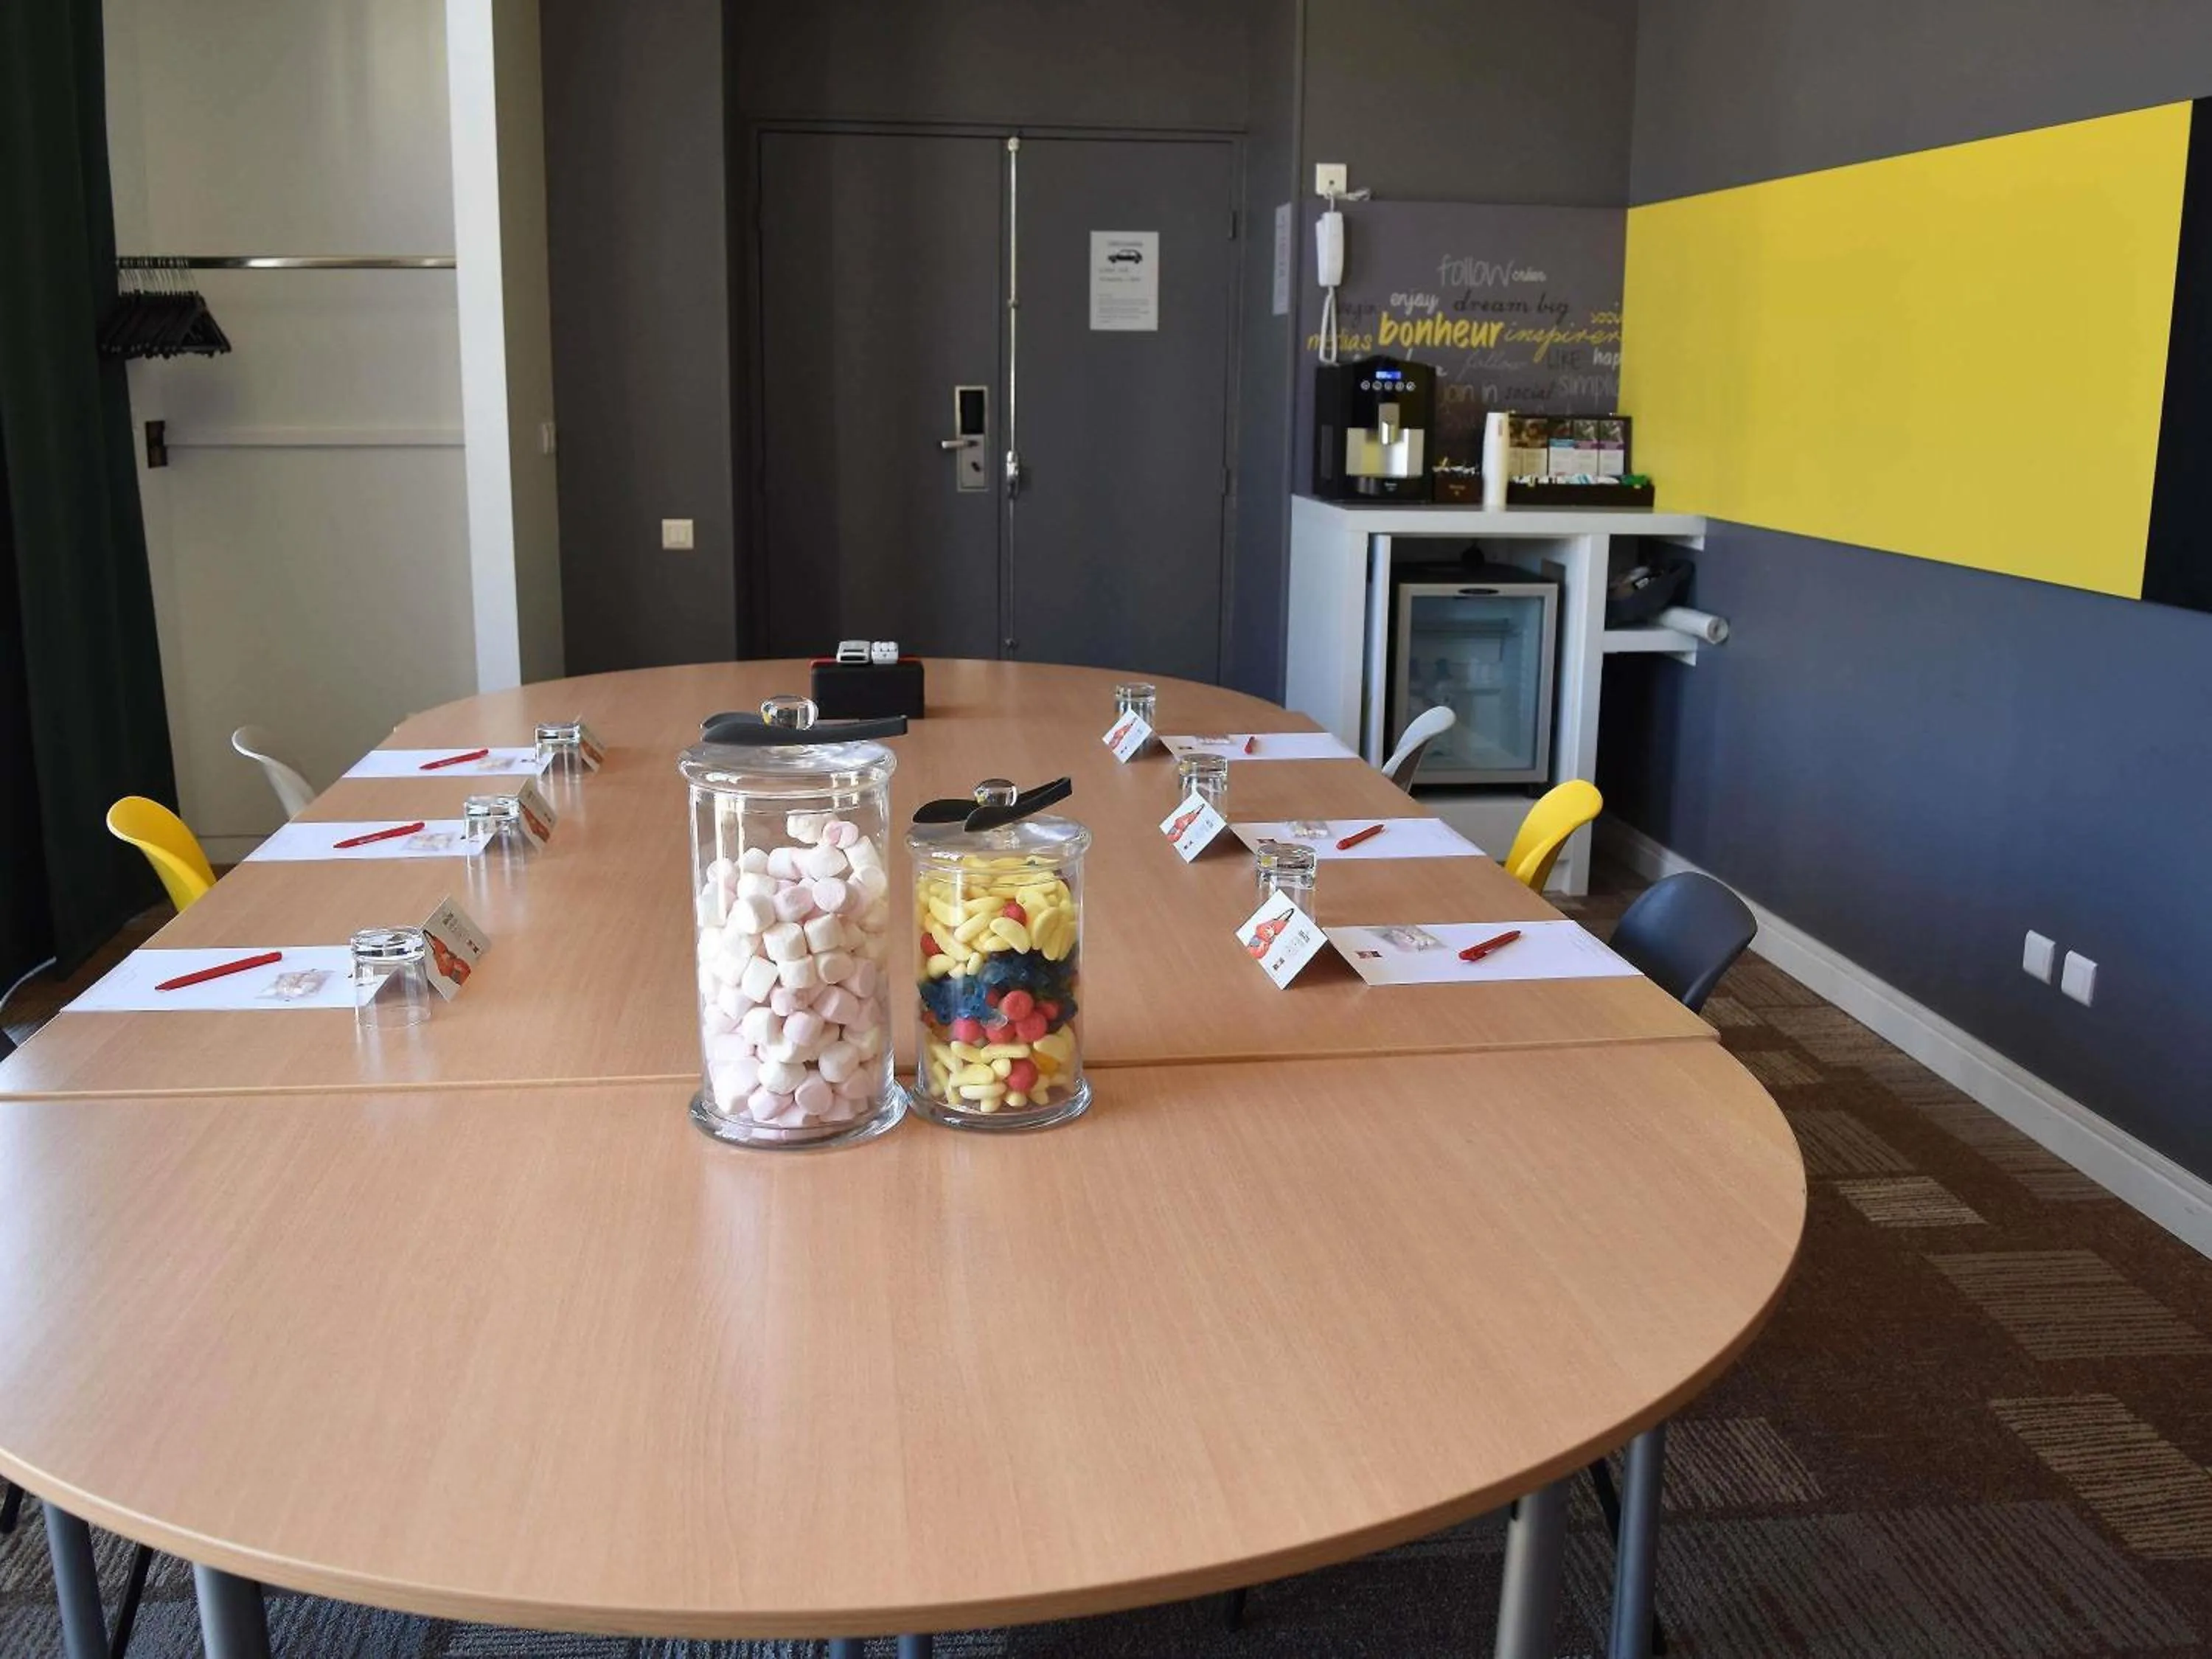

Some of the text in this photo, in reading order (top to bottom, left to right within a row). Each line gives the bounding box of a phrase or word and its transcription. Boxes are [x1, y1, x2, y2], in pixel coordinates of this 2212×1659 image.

[1436, 254, 1515, 288] follow
[1390, 292, 1440, 316] enjoy
[1453, 289, 1529, 314] dream
[1378, 311, 1505, 349] bonheur
